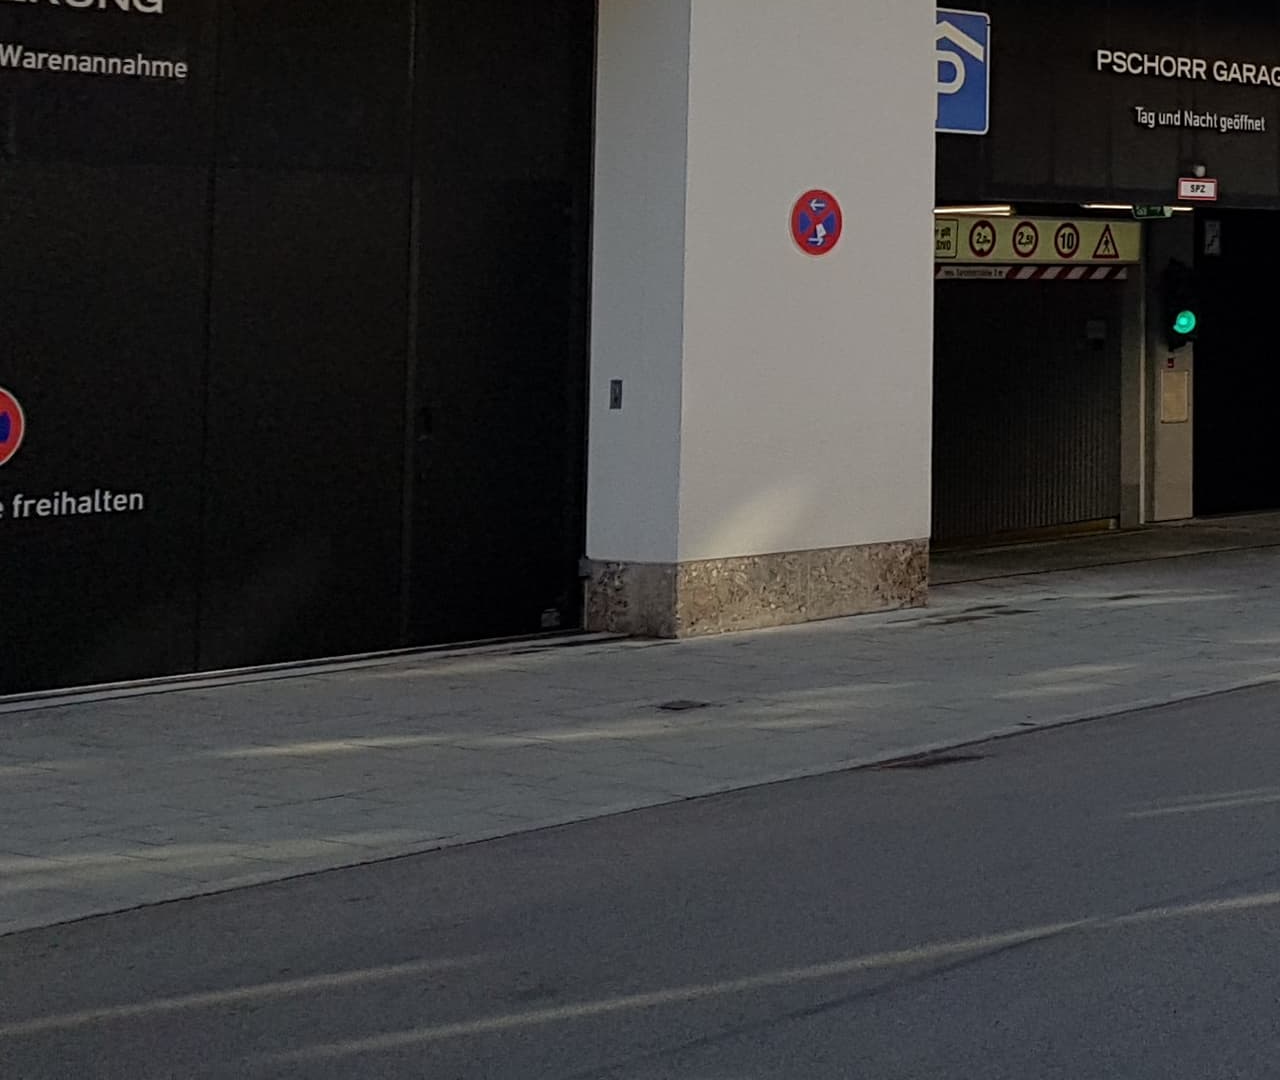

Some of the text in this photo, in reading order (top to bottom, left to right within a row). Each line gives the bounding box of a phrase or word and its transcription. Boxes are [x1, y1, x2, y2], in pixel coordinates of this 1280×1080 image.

[0, 43, 188, 78] Warenannahme
[1096, 49, 1207, 80] PSCHORR
[1135, 106, 1266, 132] Tag und Nacht geöffnet
[1060, 232, 1074, 250] 10
[12, 488, 144, 519] freihalten
